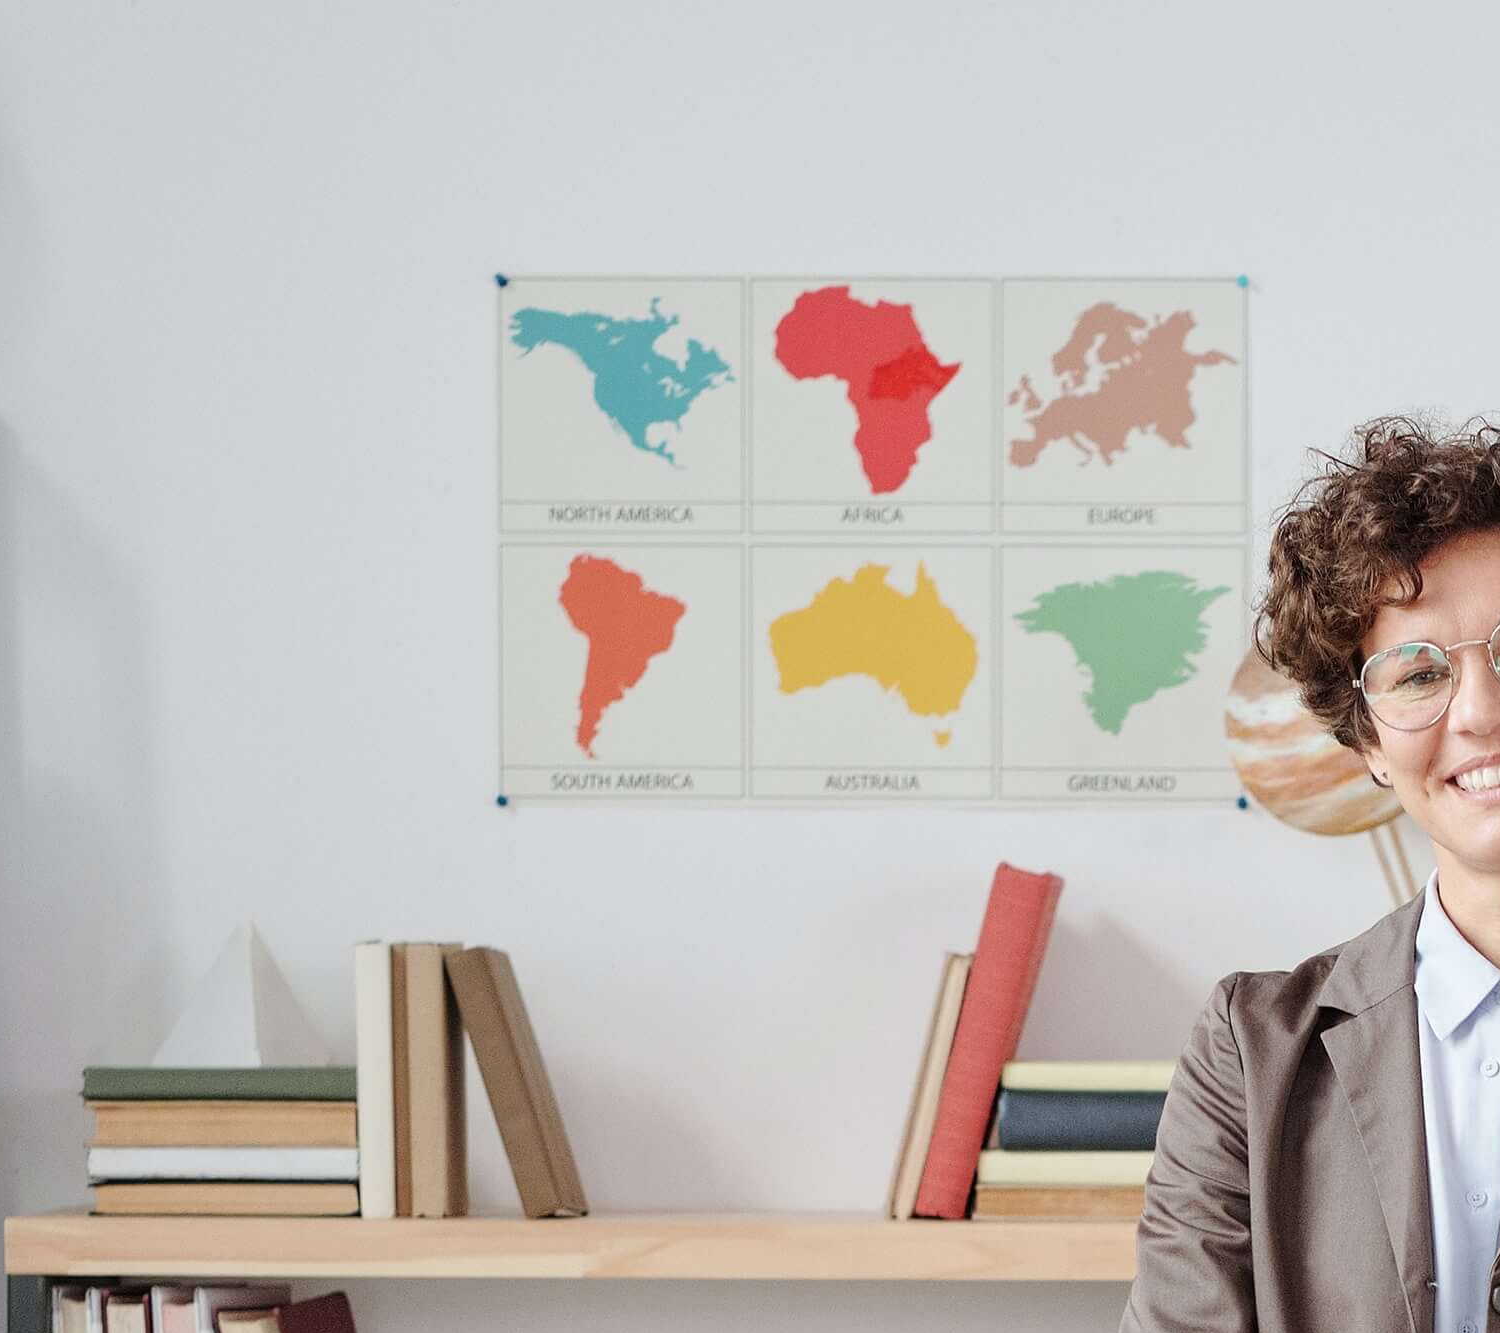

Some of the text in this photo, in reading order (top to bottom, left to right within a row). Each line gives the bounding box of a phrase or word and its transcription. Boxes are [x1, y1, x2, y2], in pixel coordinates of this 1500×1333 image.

[548, 506, 694, 523] NORTH AMERICA
[841, 507, 904, 524] AFRICA
[1087, 507, 1156, 525] EUROPE
[550, 772, 694, 790] SOUTH AMERICA
[824, 773, 920, 791] AUSTRALIA
[1067, 774, 1177, 793] GREENLAND
